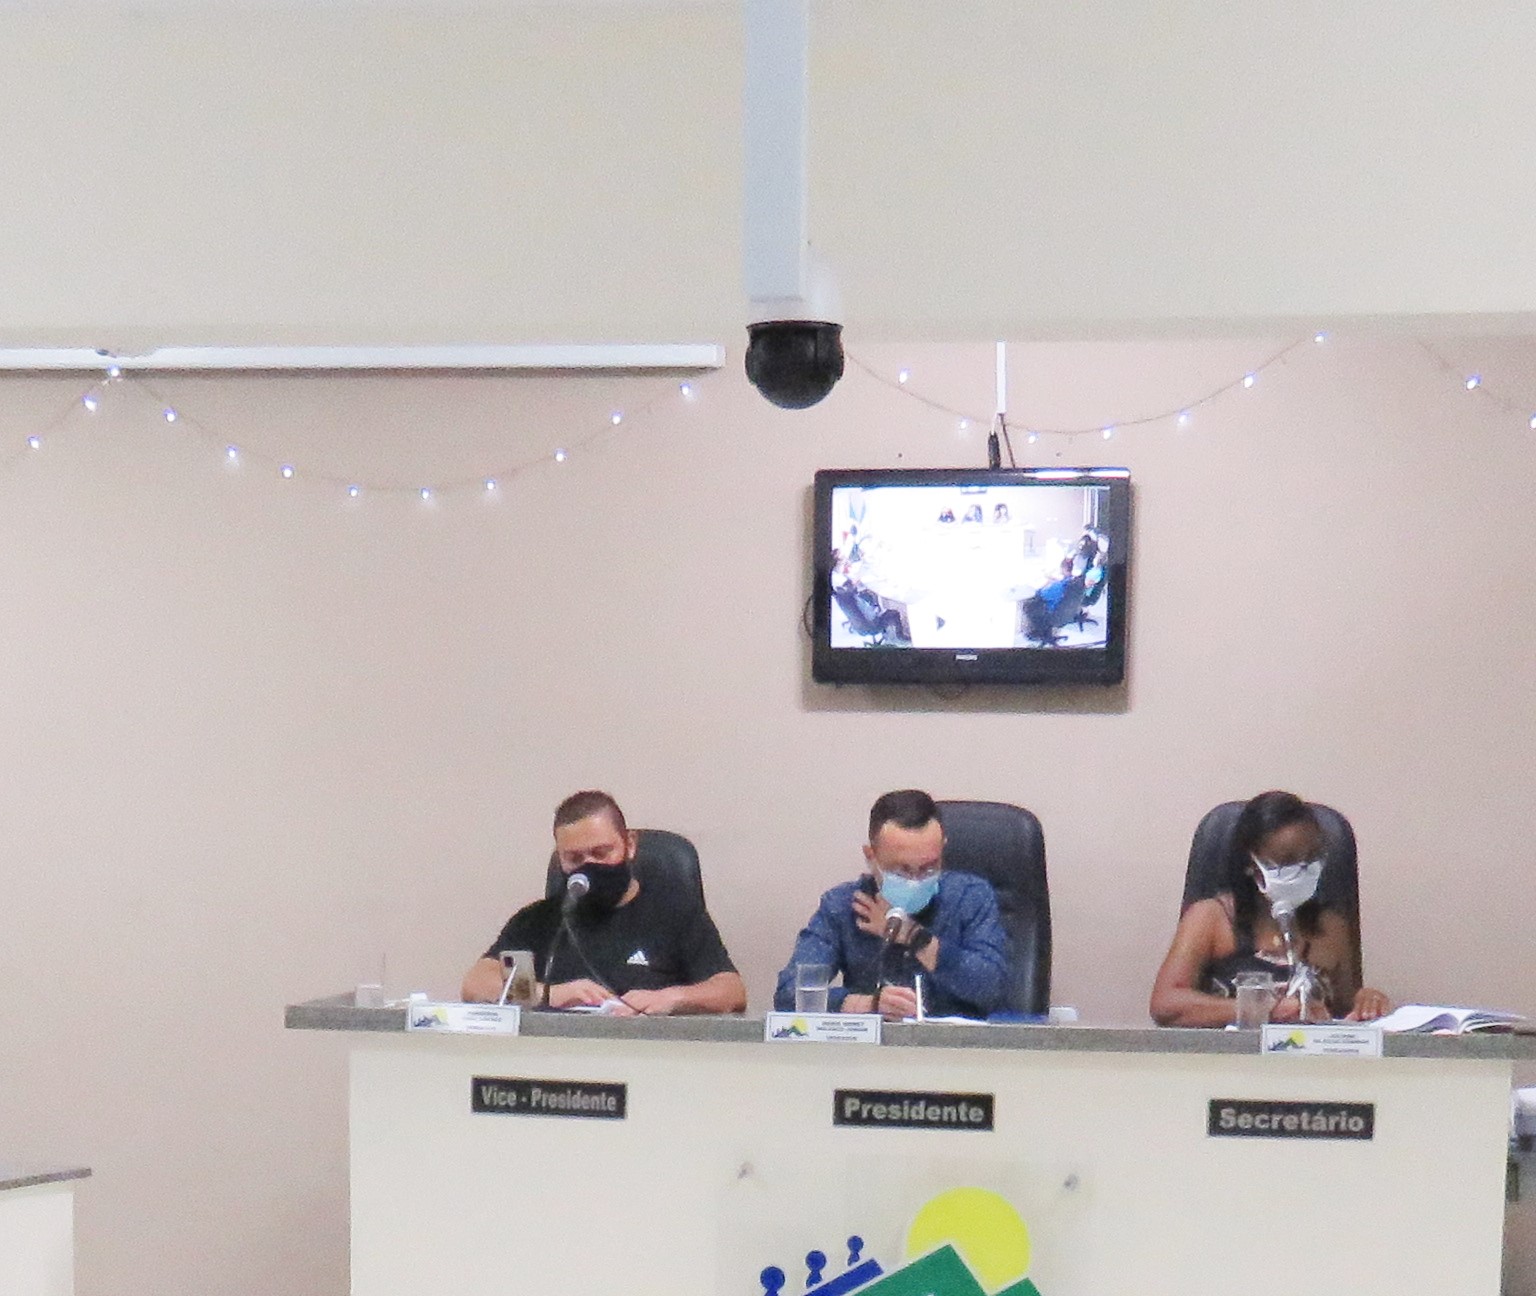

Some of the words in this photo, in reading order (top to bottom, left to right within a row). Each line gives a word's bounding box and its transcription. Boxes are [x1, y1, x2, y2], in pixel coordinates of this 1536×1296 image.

[480, 1085, 517, 1107] Vice
[530, 1087, 617, 1112] Presidente
[843, 1097, 985, 1123] Presidente
[1219, 1107, 1365, 1133] Secretário
